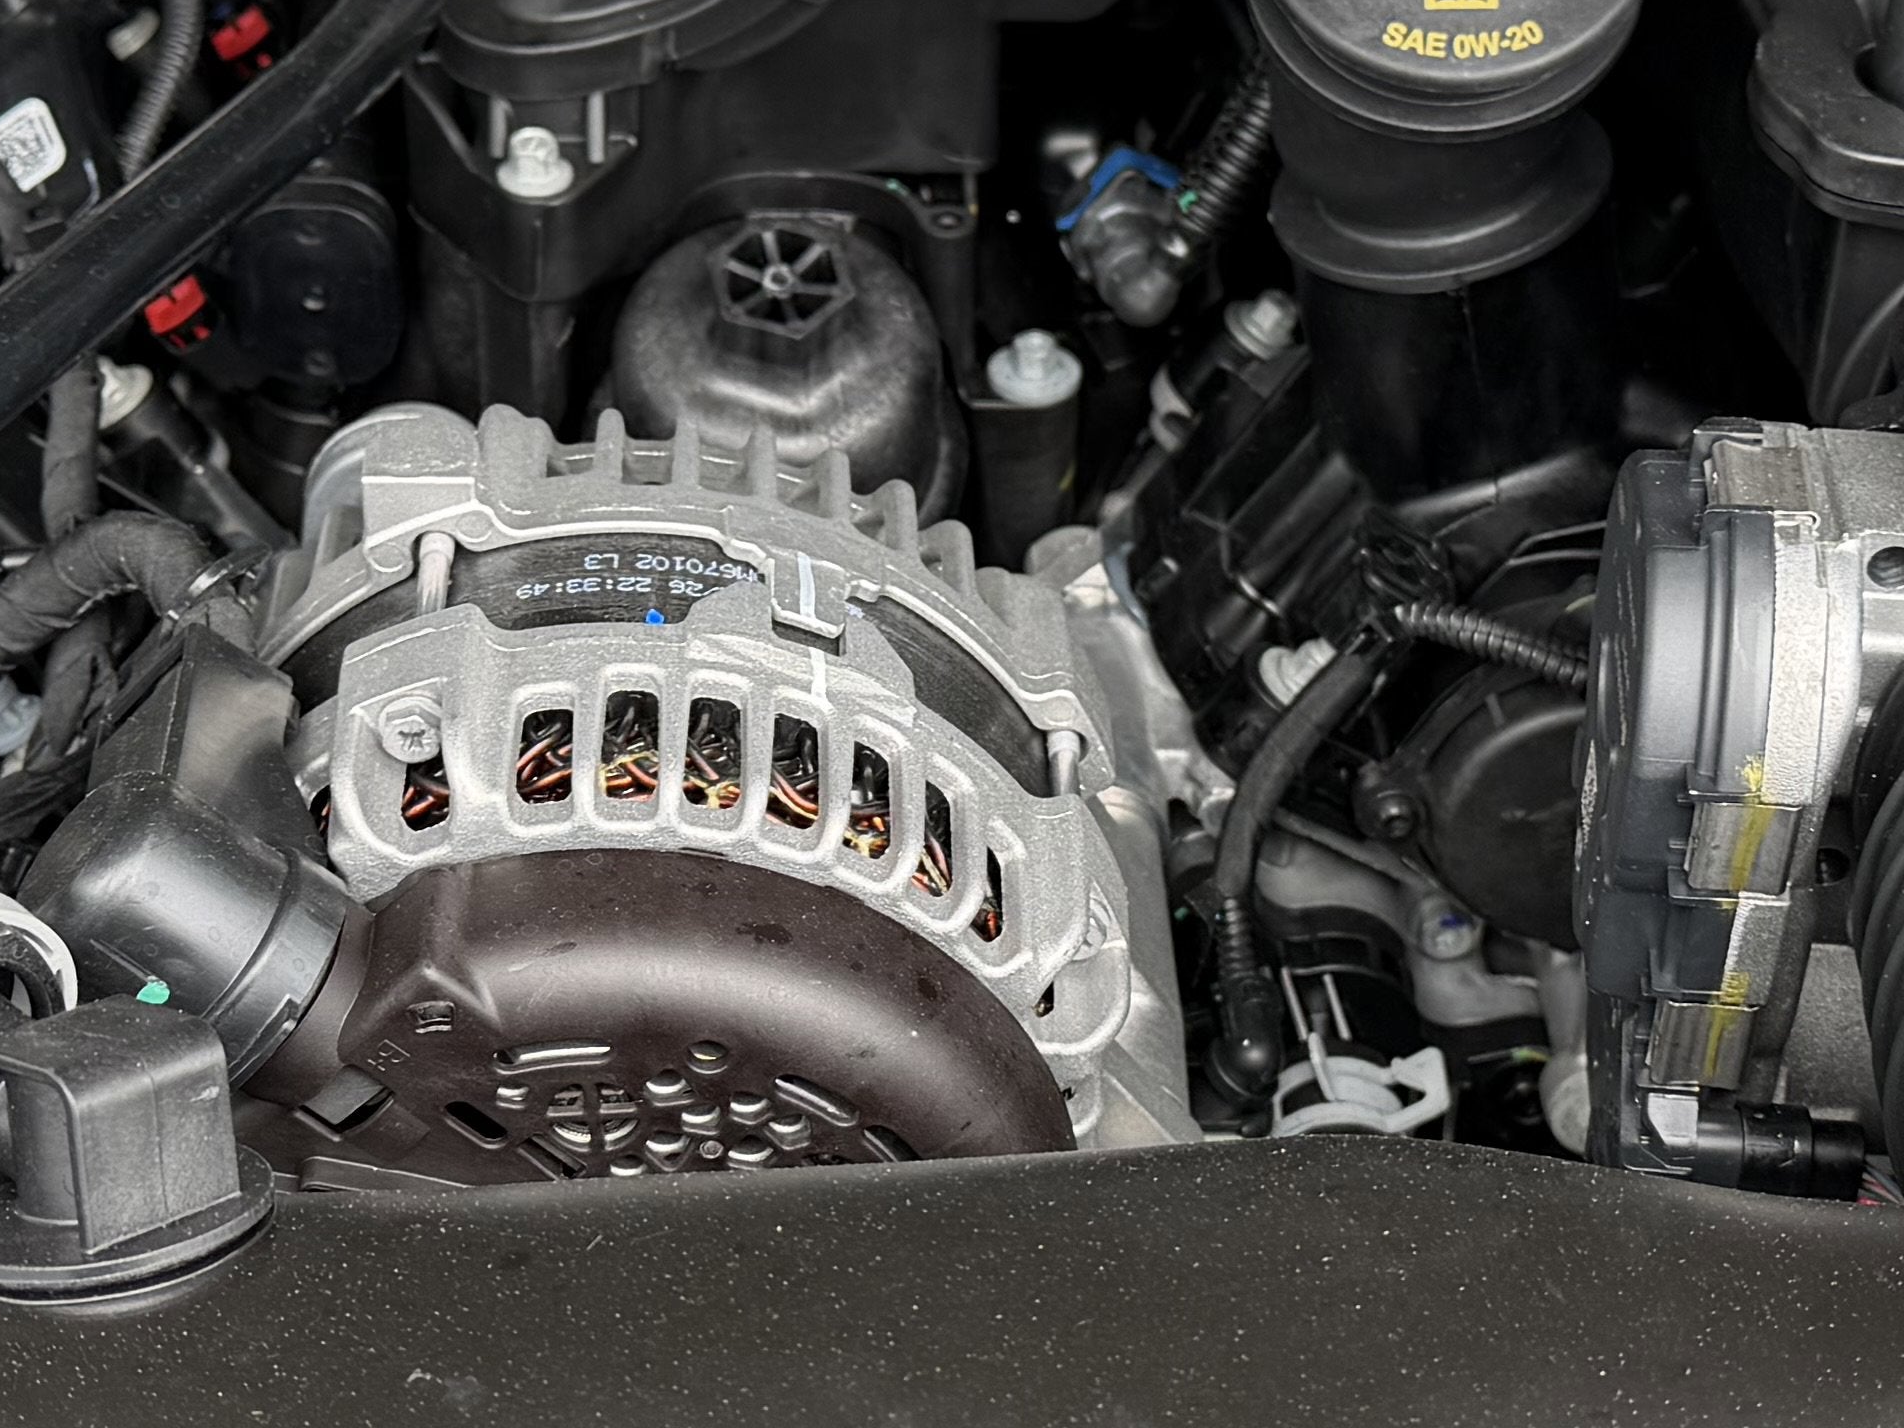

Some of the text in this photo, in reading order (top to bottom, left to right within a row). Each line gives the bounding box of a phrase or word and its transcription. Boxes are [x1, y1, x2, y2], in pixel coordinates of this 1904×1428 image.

[1381, 19, 1545, 60] SAE 0W-20
[583, 550, 760, 584] M670102 L3
[514, 574, 653, 600] 22:33:49
